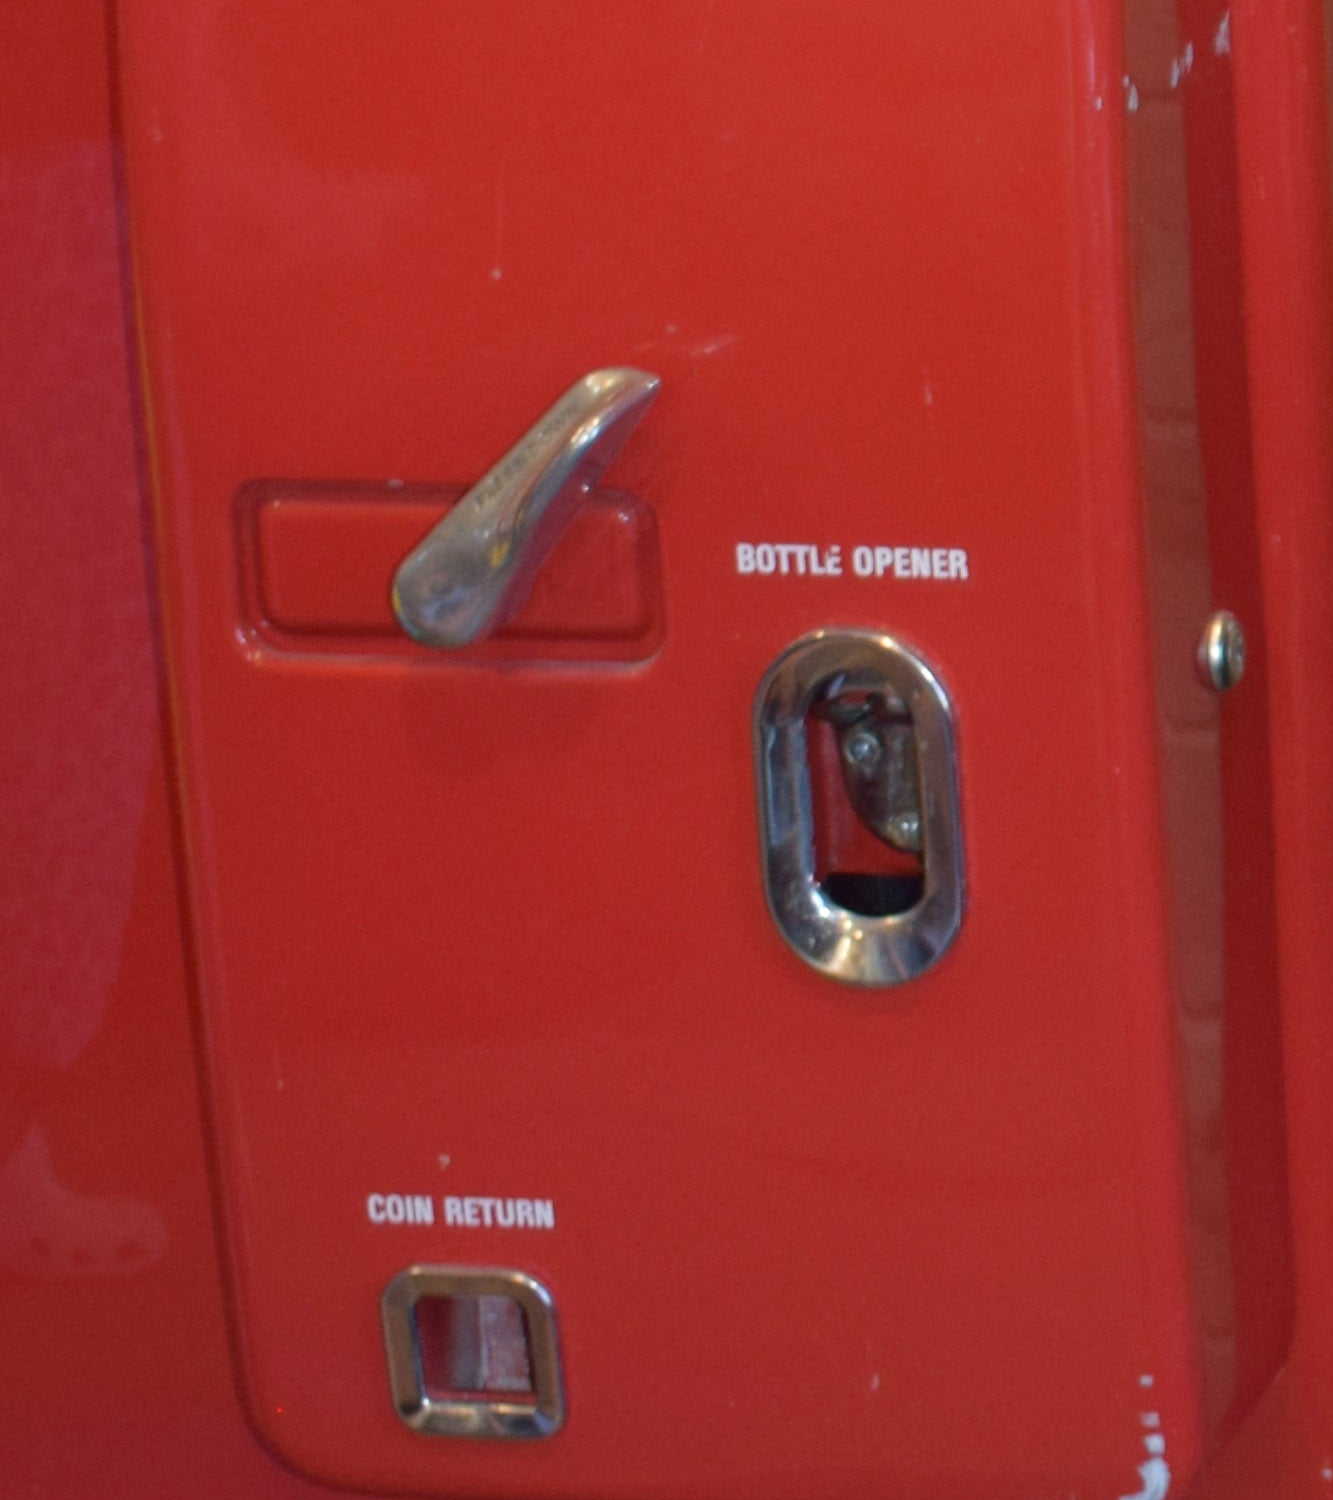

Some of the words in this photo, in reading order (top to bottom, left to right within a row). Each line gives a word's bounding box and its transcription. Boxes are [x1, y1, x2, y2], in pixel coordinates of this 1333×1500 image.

[735, 542, 843, 577] BOTTLE
[852, 545, 969, 581] OPENER
[367, 1193, 434, 1226] COIN
[443, 1195, 555, 1229] RETURN
